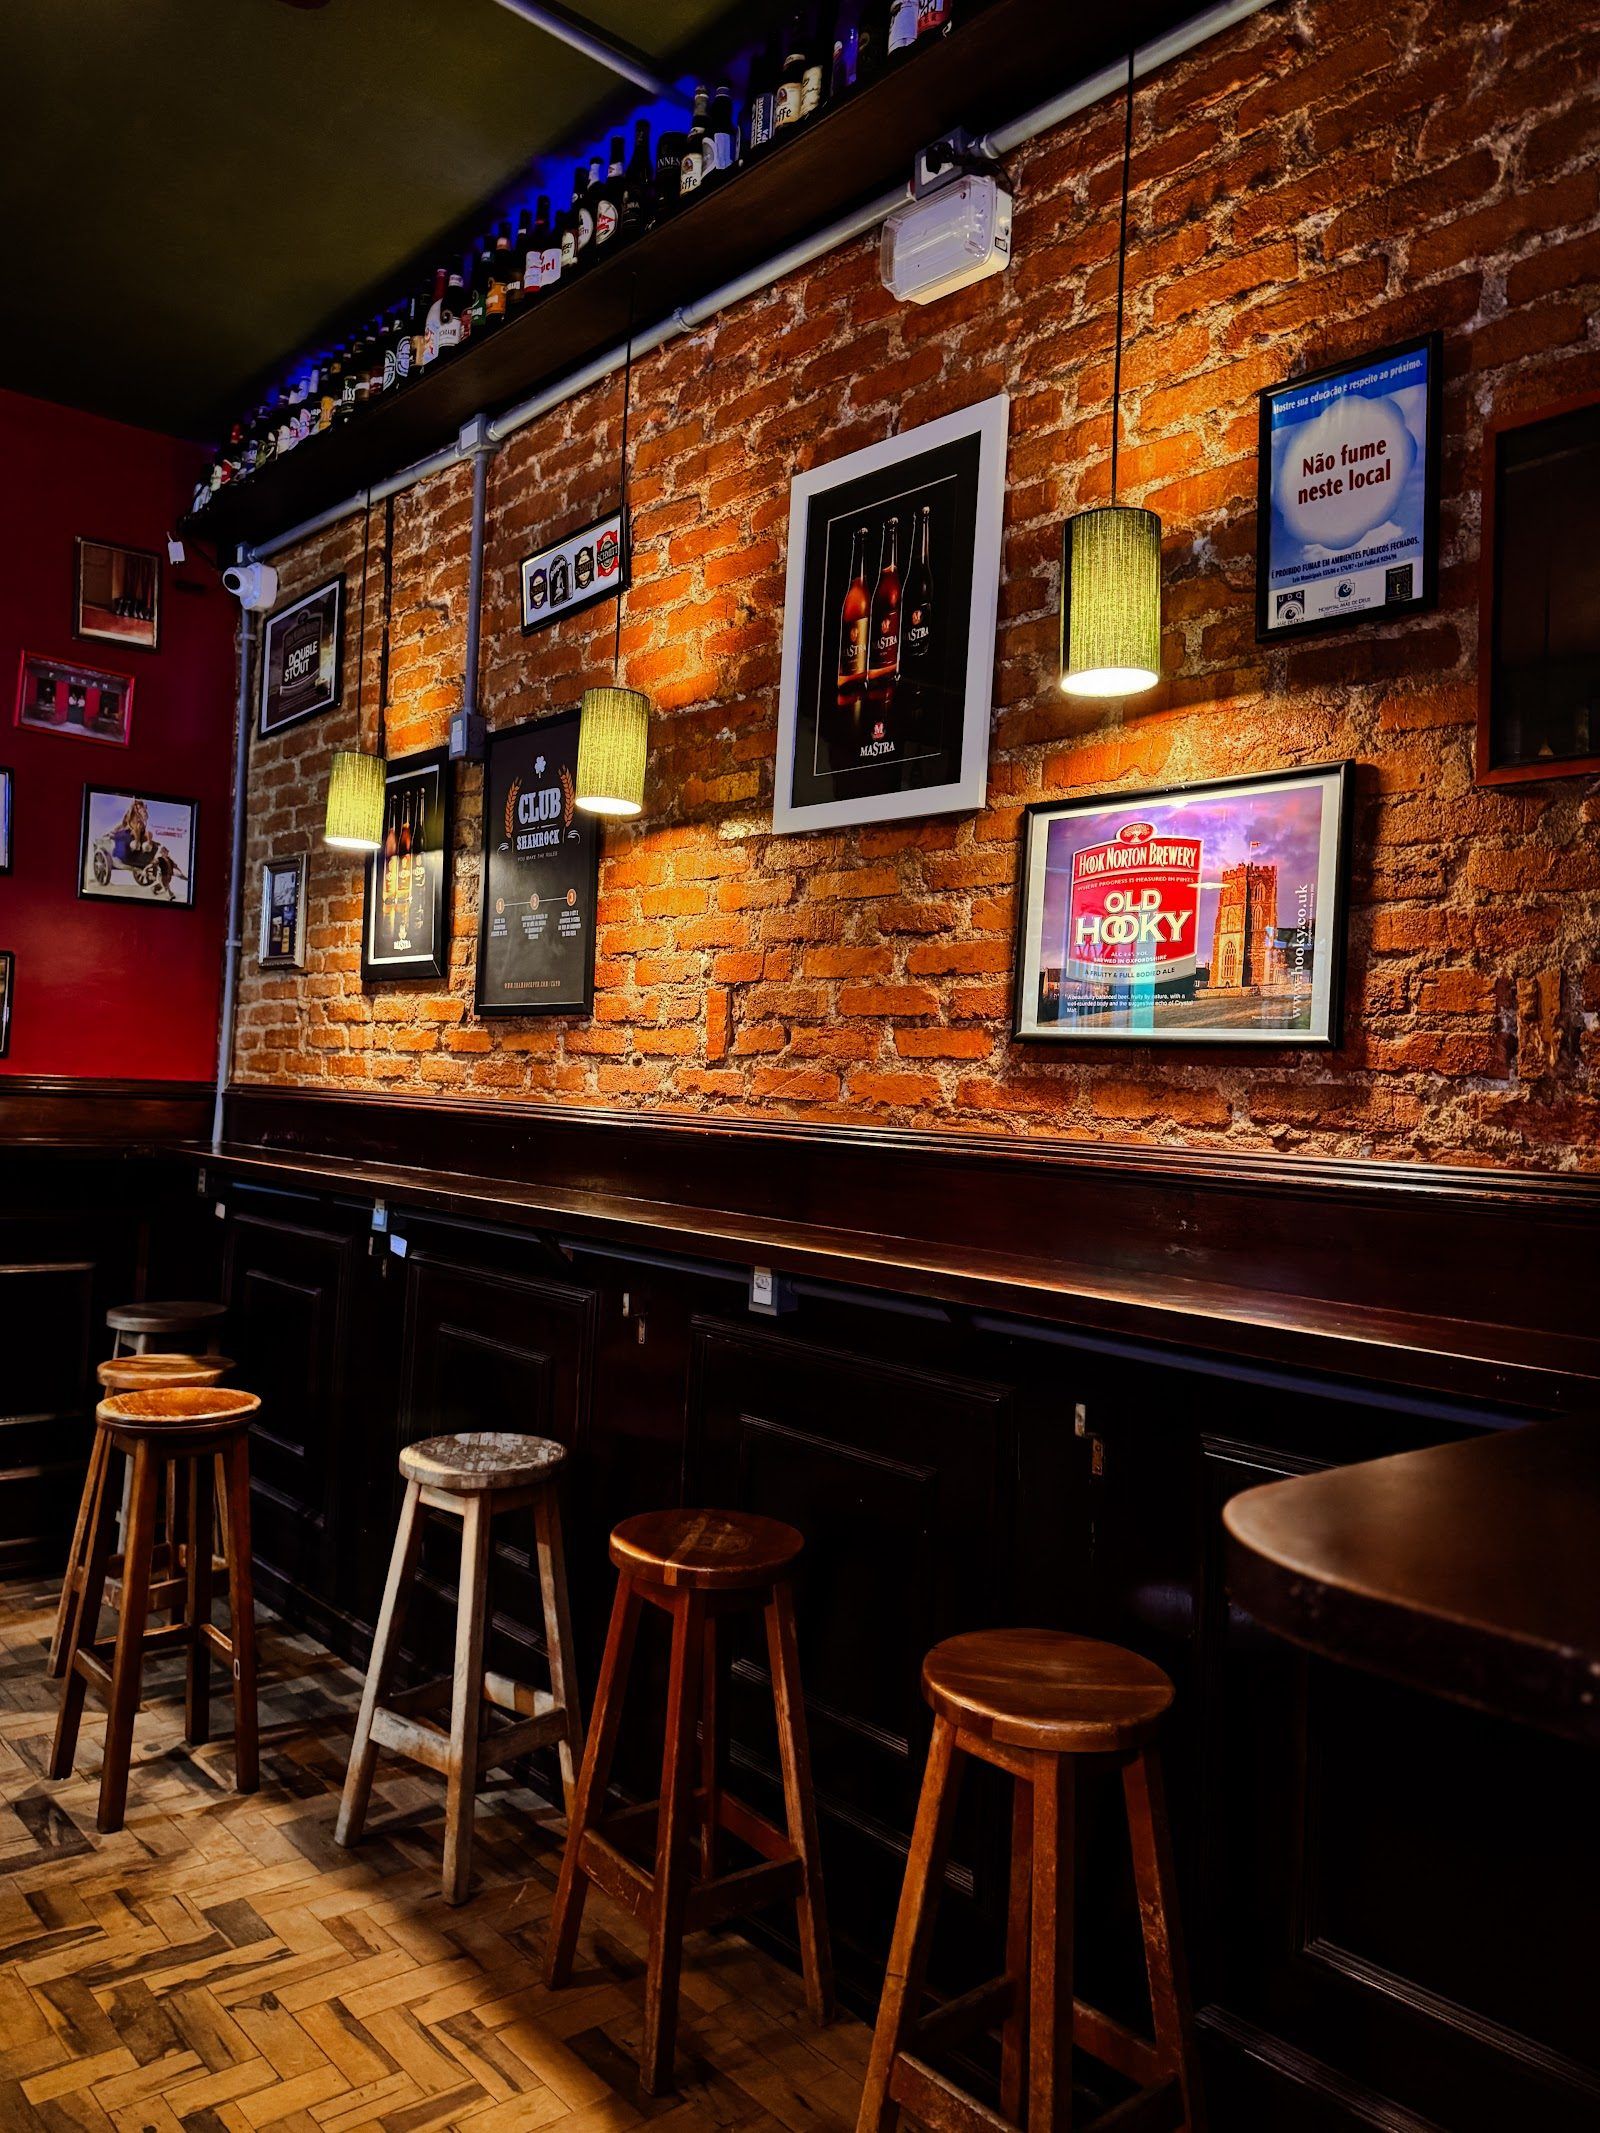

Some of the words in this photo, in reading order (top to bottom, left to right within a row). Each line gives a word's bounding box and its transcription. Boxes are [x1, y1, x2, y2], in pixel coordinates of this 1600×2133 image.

[757, 96, 765, 144] HARDCORE
[1297, 397, 1309, 408] sua
[1310, 386, 1342, 405] educação
[1342, 383, 1348, 392] e
[1348, 374, 1379, 392] respeito
[1379, 369, 1389, 380] ao
[1303, 452, 1336, 478] Não
[1341, 439, 1387, 466] fume
[1298, 478, 1344, 505] neste
[1349, 458, 1391, 491] local
[1275, 565, 1302, 579] PROIBIDO
[1302, 560, 1321, 573] FUMAR
[1322, 557, 1331, 568] EM
[1331, 549, 1362, 566] AMBIENTES
[1362, 544, 1389, 558] PÚBLICOS
[284, 658, 310, 683] STOUT
[288, 641, 318, 668] DOUBLE
[859, 741, 896, 758] MASTRA
[518, 787, 562, 825] CLUB
[516, 829, 560, 851] SHAMROCK
[1078, 852, 1106, 878] HOOK
[1106, 846, 1148, 870] NORTON
[1148, 842, 1198, 869] BREWERY
[1077, 882, 1098, 891] WHERE
[1099, 879, 1129, 888] PROGRESS
[1135, 876, 1167, 884] MEASURED
[1104, 888, 1162, 914] OLD
[1074, 910, 1194, 946] HOOKY
[1125, 954, 1168, 964] OXFORDSHIRE
[1290, 884, 1308, 1020] www.hooky.co.uk
[1090, 970, 1112, 978] FRUITY
[1118, 971, 1135, 979] FULL
[1135, 969, 1161, 978] BODIED
[1161, 966, 1176, 975] ALE
